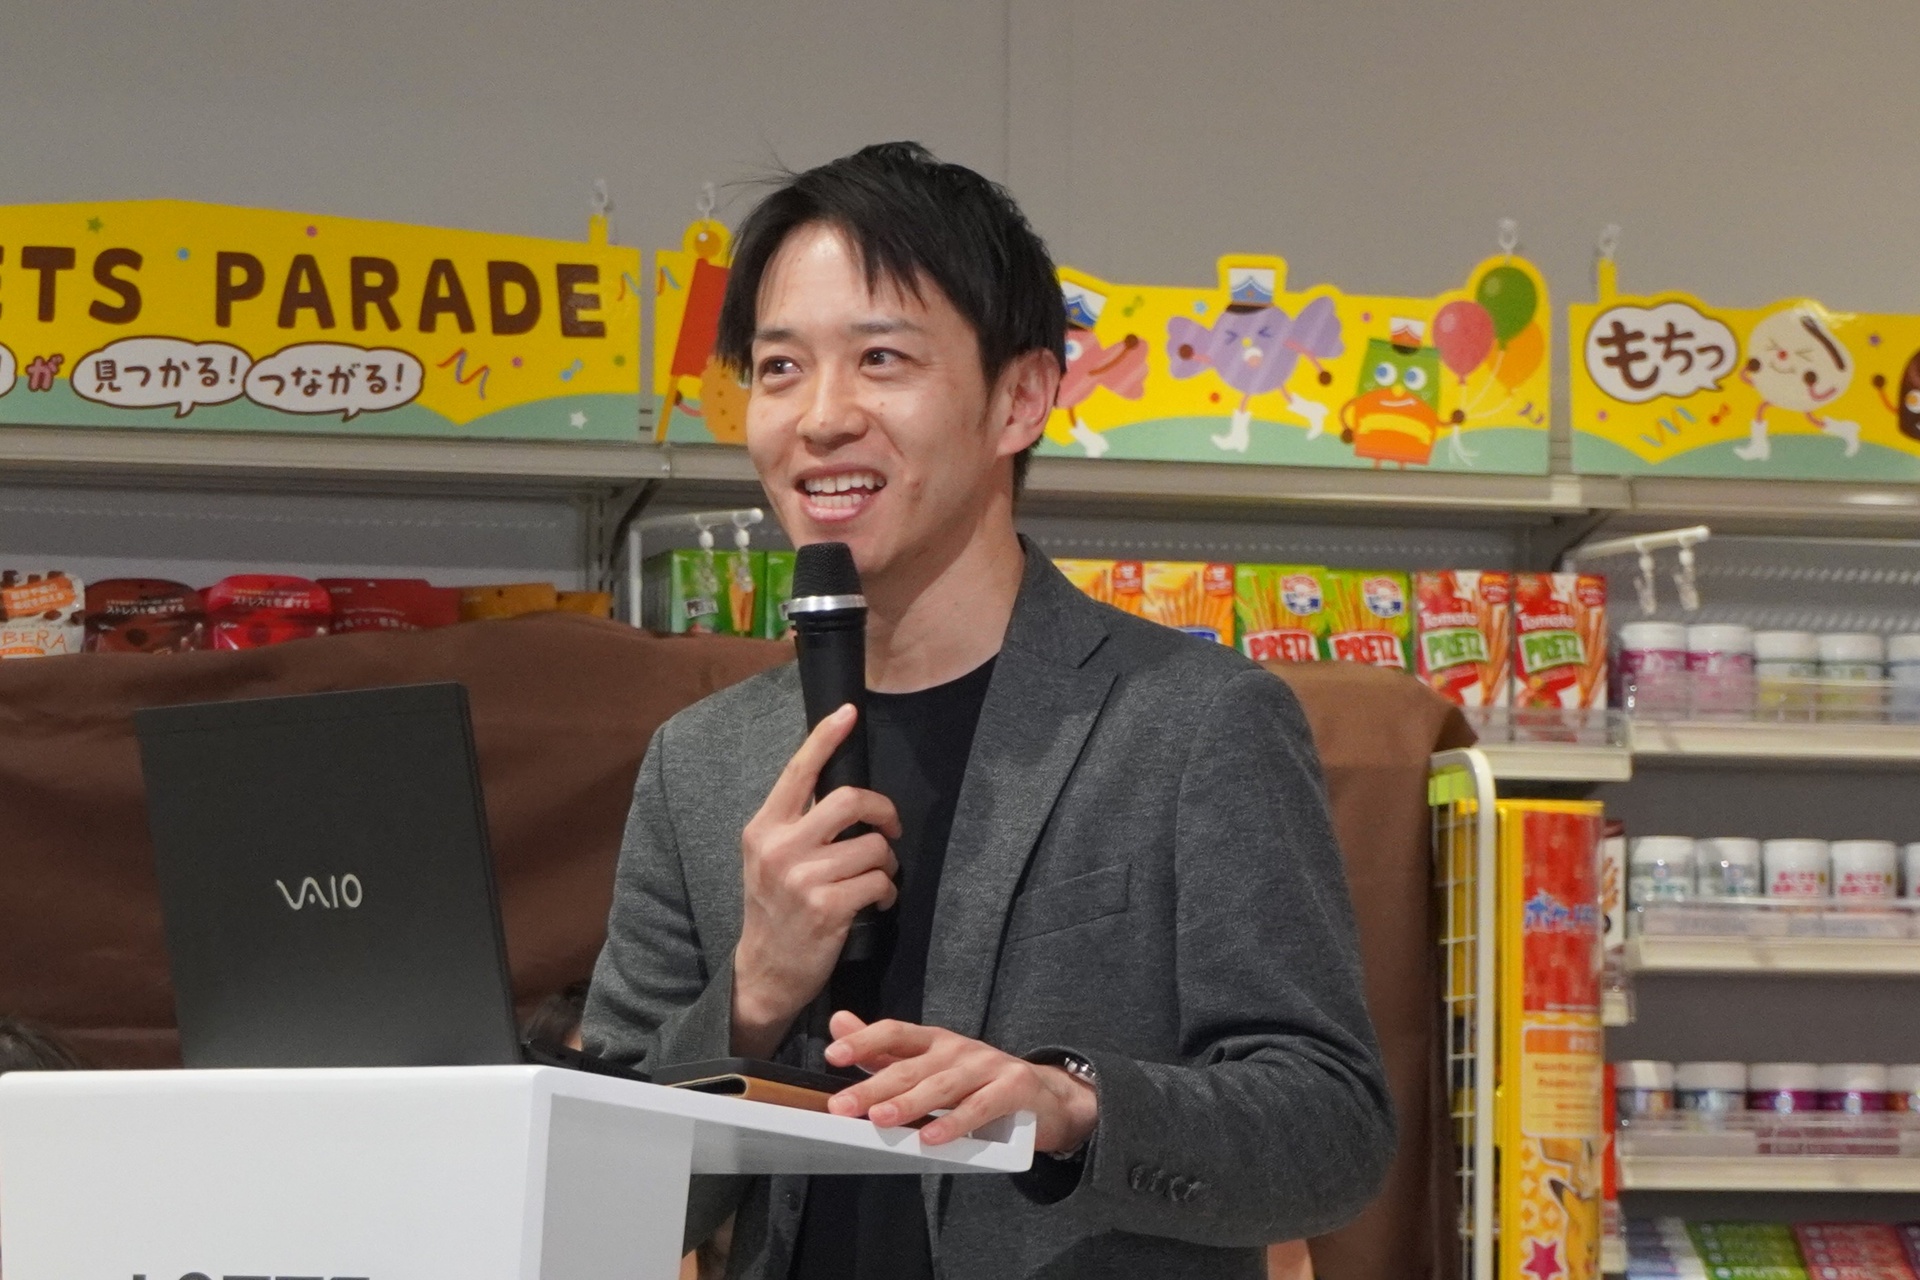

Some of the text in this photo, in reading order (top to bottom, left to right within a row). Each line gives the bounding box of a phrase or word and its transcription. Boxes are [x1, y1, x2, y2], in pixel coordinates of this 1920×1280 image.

[0, 245, 607, 339] TS PARADE
[25, 353, 405, 397] が 見つかる! つながる!
[1598, 321, 1724, 390] もちっ
[276, 873, 363, 910] VAIO
